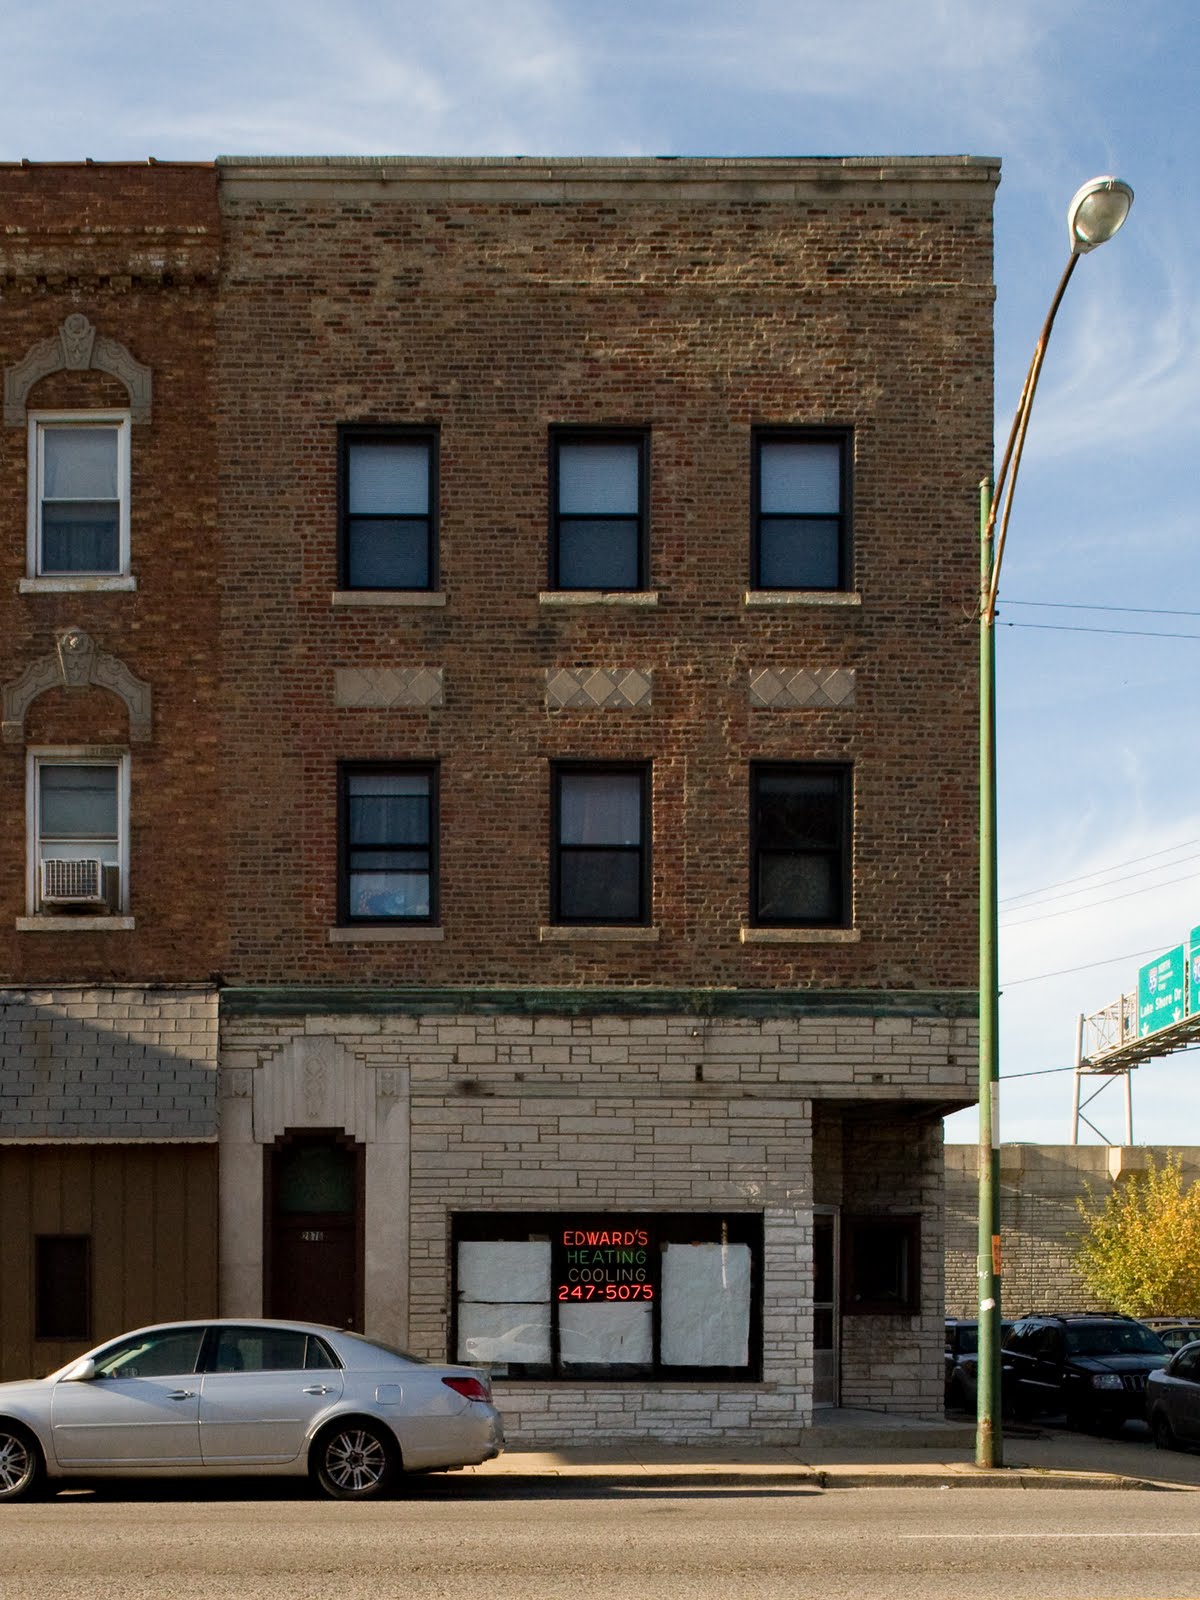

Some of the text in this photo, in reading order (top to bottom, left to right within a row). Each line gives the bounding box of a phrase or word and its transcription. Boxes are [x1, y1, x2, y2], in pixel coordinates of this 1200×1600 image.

[563, 1229, 648, 1246] EDWARD'S
[567, 1250, 647, 1264] HEATING
[568, 1268, 647, 1282] COOLING
[558, 1285, 653, 1300] 247-5075
